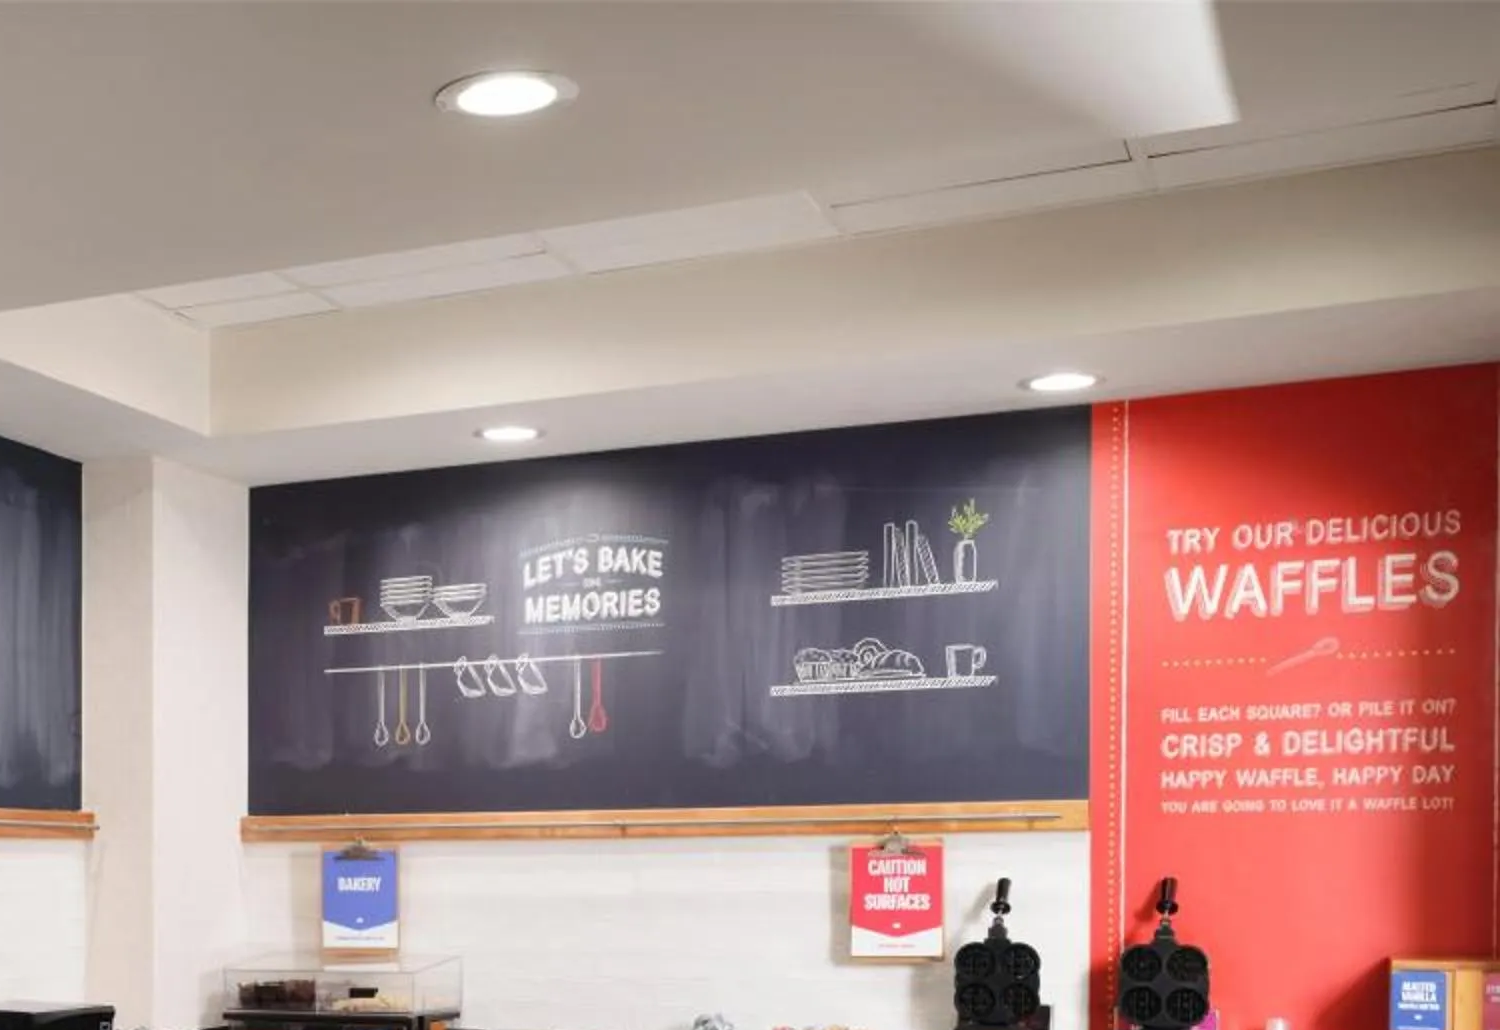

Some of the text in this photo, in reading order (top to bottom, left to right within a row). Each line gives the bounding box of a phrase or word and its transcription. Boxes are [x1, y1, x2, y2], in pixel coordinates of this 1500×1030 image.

[1167, 509, 1461, 555] TRY OUR DELICIOUS
[523, 545, 664, 589] LET'S BAKE
[1164, 550, 1460, 622] WAFFLES
[524, 587, 661, 624] MEMORIES
[1161, 698, 1456, 723] FILL EACH SQUARE? OR PILE IT ON?
[1161, 727, 1455, 759] CRISP & DELIGHTFUL
[1161, 765, 1455, 790] HAPPY WAFFLE, HAPPY DAY
[1161, 801, 1187, 813] YOU
[1191, 800, 1218, 813] ARE
[1222, 799, 1264, 813] GOING
[1270, 799, 1286, 812] TO
[1291, 798, 1325, 812] LOVE
[1330, 798, 1343, 812] IT
[1348, 798, 1358, 812] A
[1363, 797, 1417, 812] WAFFLE
[868, 859, 927, 876] CAUTION
[338, 876, 381, 892] BAKERY
[884, 876, 910, 893] HOT
[864, 893, 931, 911] SURFACES
